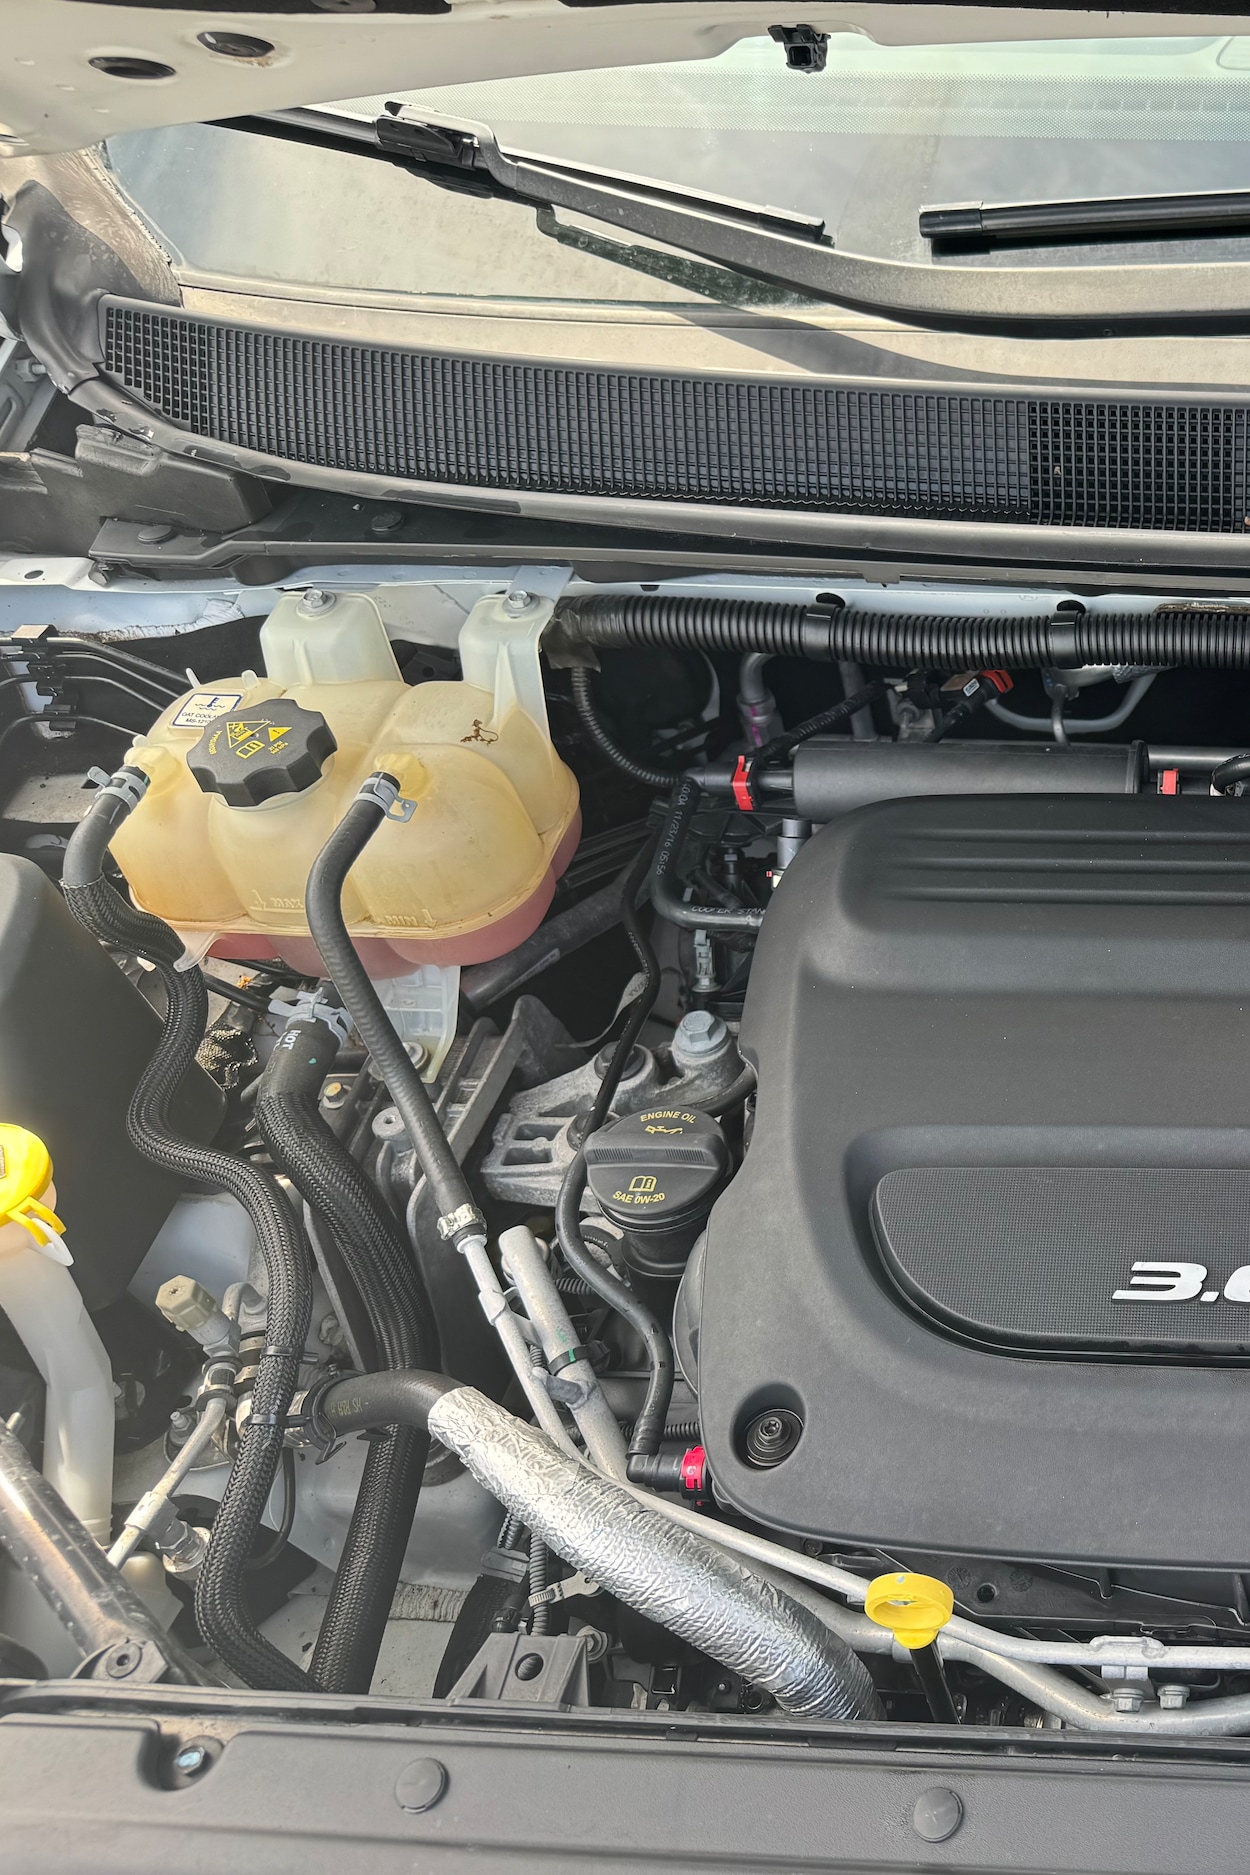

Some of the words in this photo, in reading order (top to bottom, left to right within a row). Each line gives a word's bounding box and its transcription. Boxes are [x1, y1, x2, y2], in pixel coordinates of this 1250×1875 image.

[282, 1029, 302, 1050] HOT
[640, 1110, 681, 1123] ENGINE
[680, 1112, 698, 1125] OIL
[612, 1190, 634, 1204] SAE
[633, 1191, 666, 1205] 0W-20
